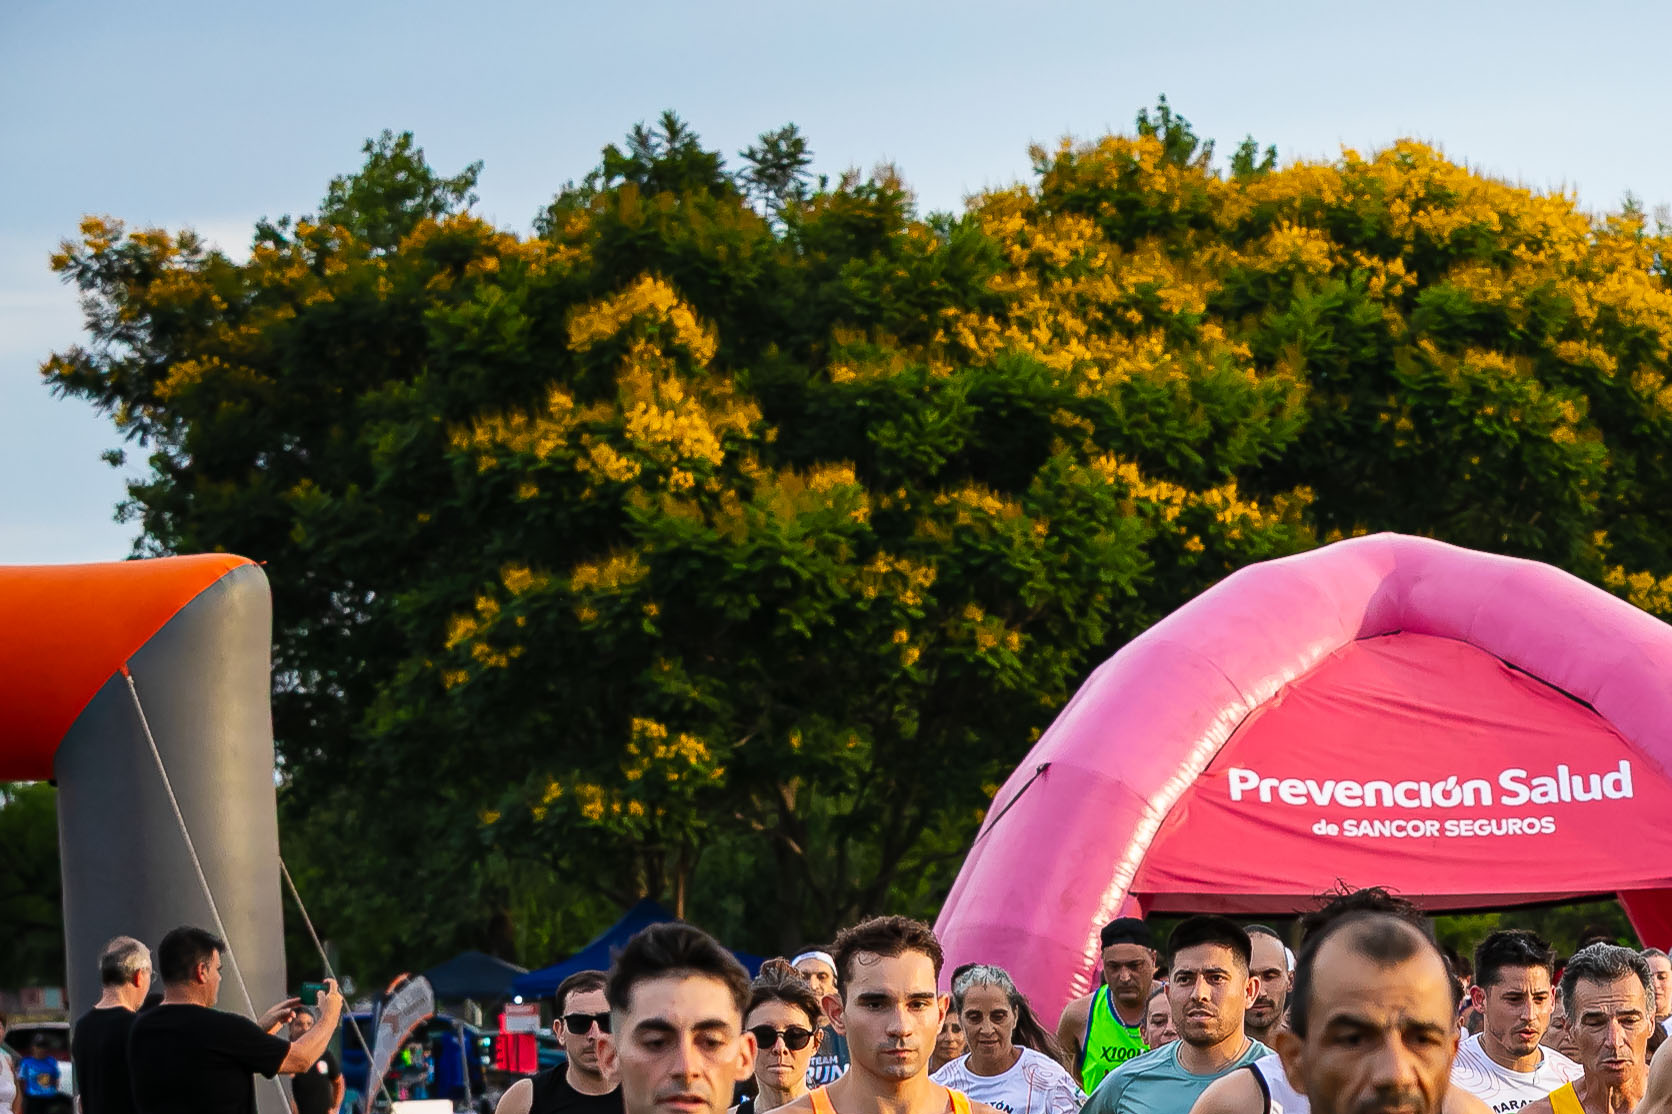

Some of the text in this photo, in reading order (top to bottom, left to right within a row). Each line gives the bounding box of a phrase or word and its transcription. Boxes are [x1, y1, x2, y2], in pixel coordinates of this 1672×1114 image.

[1227, 760, 1634, 808] Prevención Salud
[1312, 816, 1556, 838] de SANCOR SEGUROS
